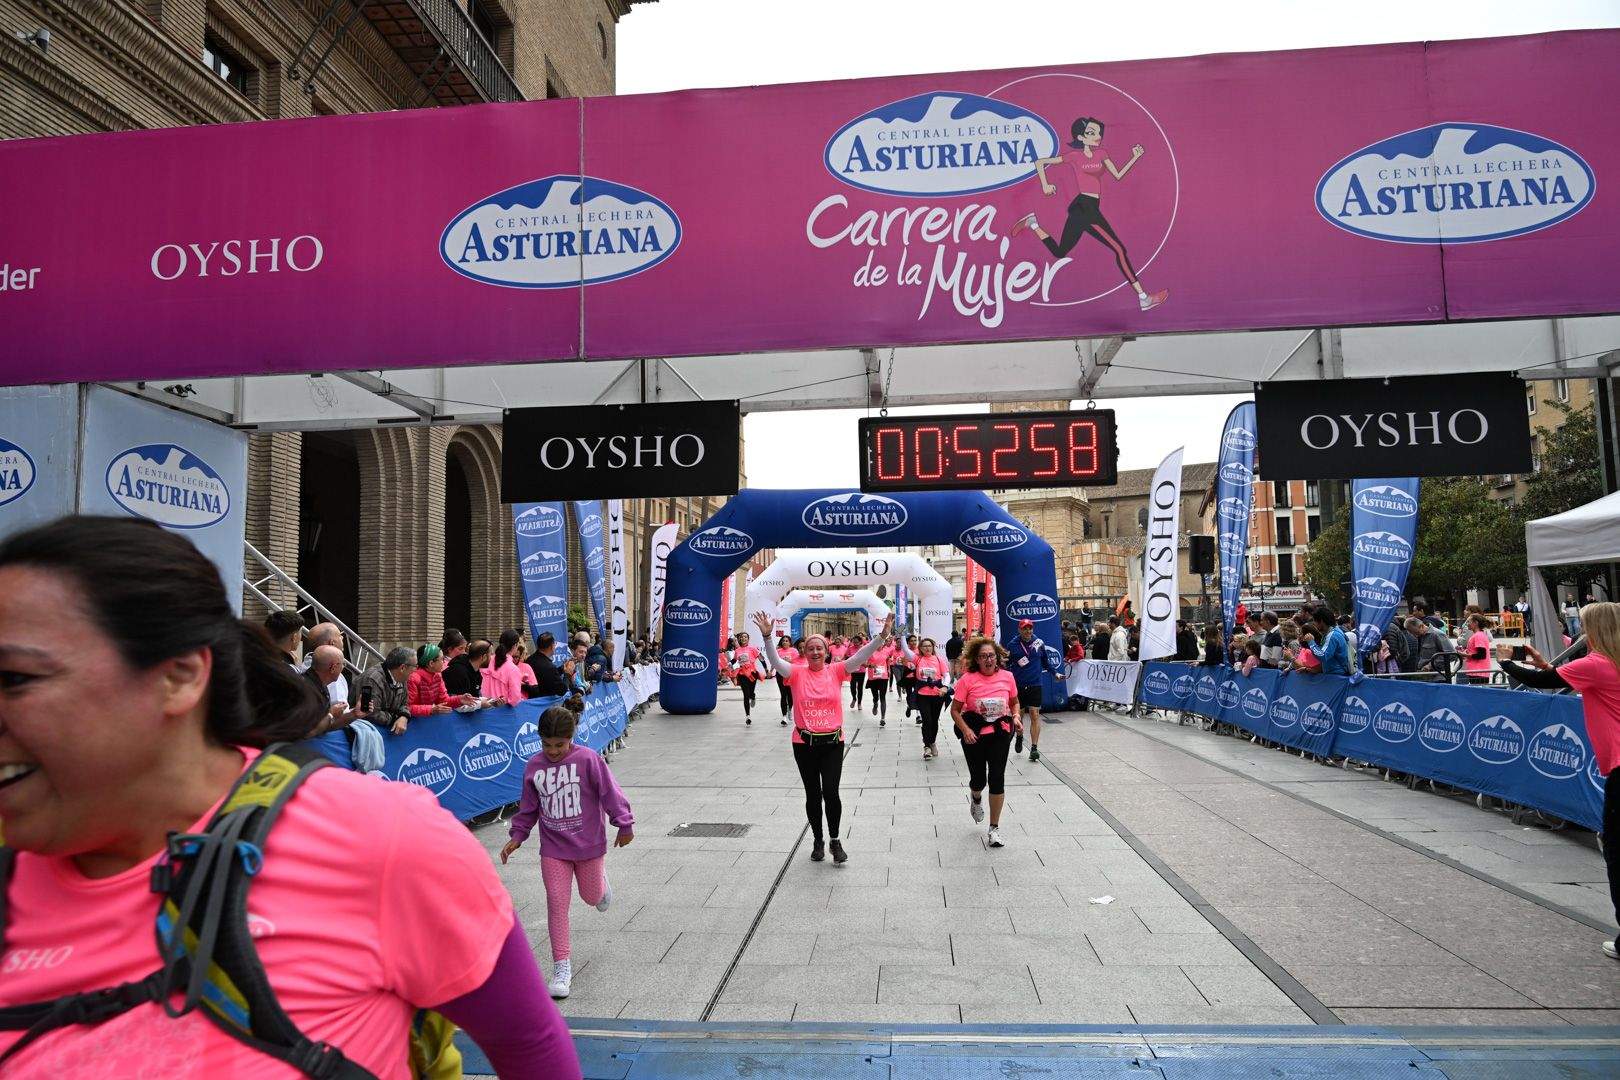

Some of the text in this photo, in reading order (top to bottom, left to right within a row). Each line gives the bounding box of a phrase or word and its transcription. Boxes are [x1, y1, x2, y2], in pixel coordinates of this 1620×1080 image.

[877, 124, 1032, 141] CENTRAL LECHERA
[842, 135, 1041, 173] ASTURIANA
[1378, 157, 1563, 180] CENTRAL LECHERA
[1337, 173, 1576, 217] ASTURIANA
[495, 209, 656, 229] CENTRAL LECHERA
[806, 194, 998, 249] Carrera
[458, 222, 663, 264] ASTURIANA
[151, 235, 324, 280] OYSHO
[853, 247, 922, 288] de la
[917, 236, 1073, 328] Mujer
[1300, 408, 1489, 450] OYSHO
[540, 433, 705, 470] OYSHO
[115, 464, 222, 515] ASTURIANA
[136, 465, 220, 491] CENTRAL LECHERA
[1358, 494, 1414, 512] ASTURIANA
[810, 507, 901, 526] ASTURIANA
[692, 537, 748, 550] ASTURIANA
[965, 534, 1023, 545] ASTURIANA
[1146, 480, 1177, 622] OYSHO
[1355, 540, 1409, 559] ASTURIANA
[807, 559, 889, 577] OYSHO
[667, 608, 709, 620] ASTURIANA
[1010, 605, 1056, 617] ASTURIANA
[662, 657, 705, 669] ASTURIANA
[1087, 663, 1127, 684] OYSHO
[1341, 712, 1367, 727] TURIANA
[1375, 714, 1412, 735] ASTURIANA
[1421, 721, 1461, 744] ASTURIANA
[1471, 729, 1519, 755] ASTURIANA
[519, 738, 542, 757] ASTURIA
[464, 749, 510, 773] ASTURIANA
[533, 763, 581, 797] REAL
